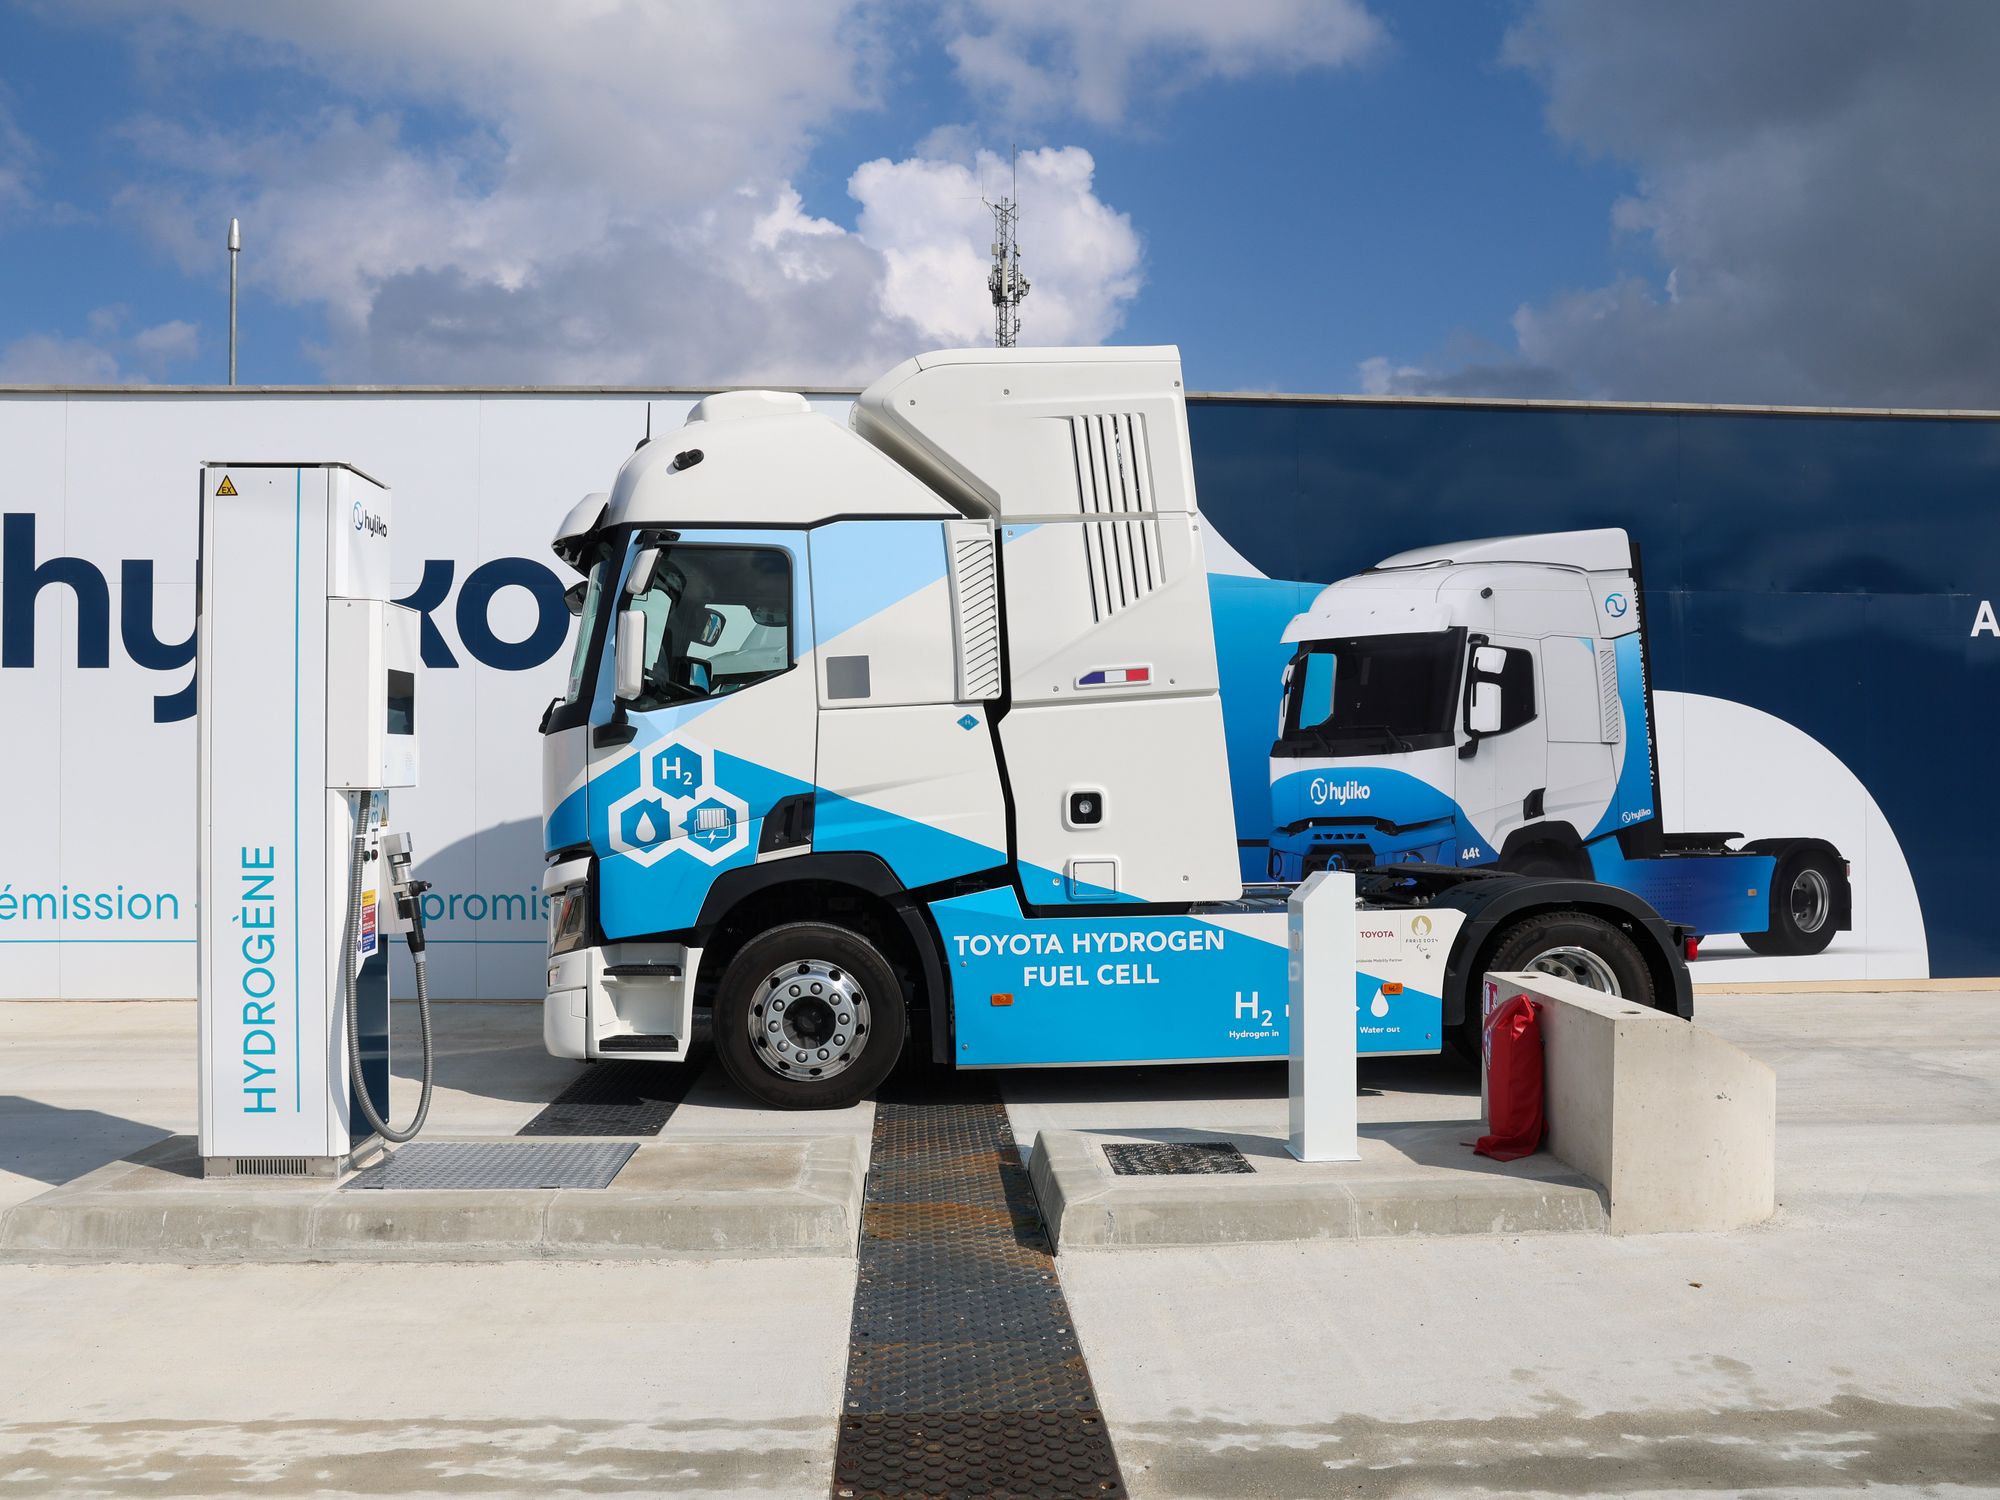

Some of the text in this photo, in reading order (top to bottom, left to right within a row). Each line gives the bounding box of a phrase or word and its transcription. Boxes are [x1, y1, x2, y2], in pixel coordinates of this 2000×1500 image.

[221, 486, 232, 495] EX
[364, 510, 388, 538] hyliko
[2, 512, 571, 724] hyko
[1970, 600, 2000, 637] A
[1329, 780, 1370, 806] hyliko
[1631, 808, 1652, 821] hyliko
[1462, 848, 1480, 860] 44t
[0, 884, 179, 920] émission
[420, 885, 551, 928] promis
[954, 930, 1224, 956] TOYOTA HYDROGEN
[1360, 930, 1394, 938] TOYOTA
[232, 846, 276, 1112] HYDROGÈNE
[1024, 964, 1159, 987] FUEL CELL
[1229, 1029, 1280, 1040] Hydrogen in
[1360, 1026, 1384, 1034] Water
